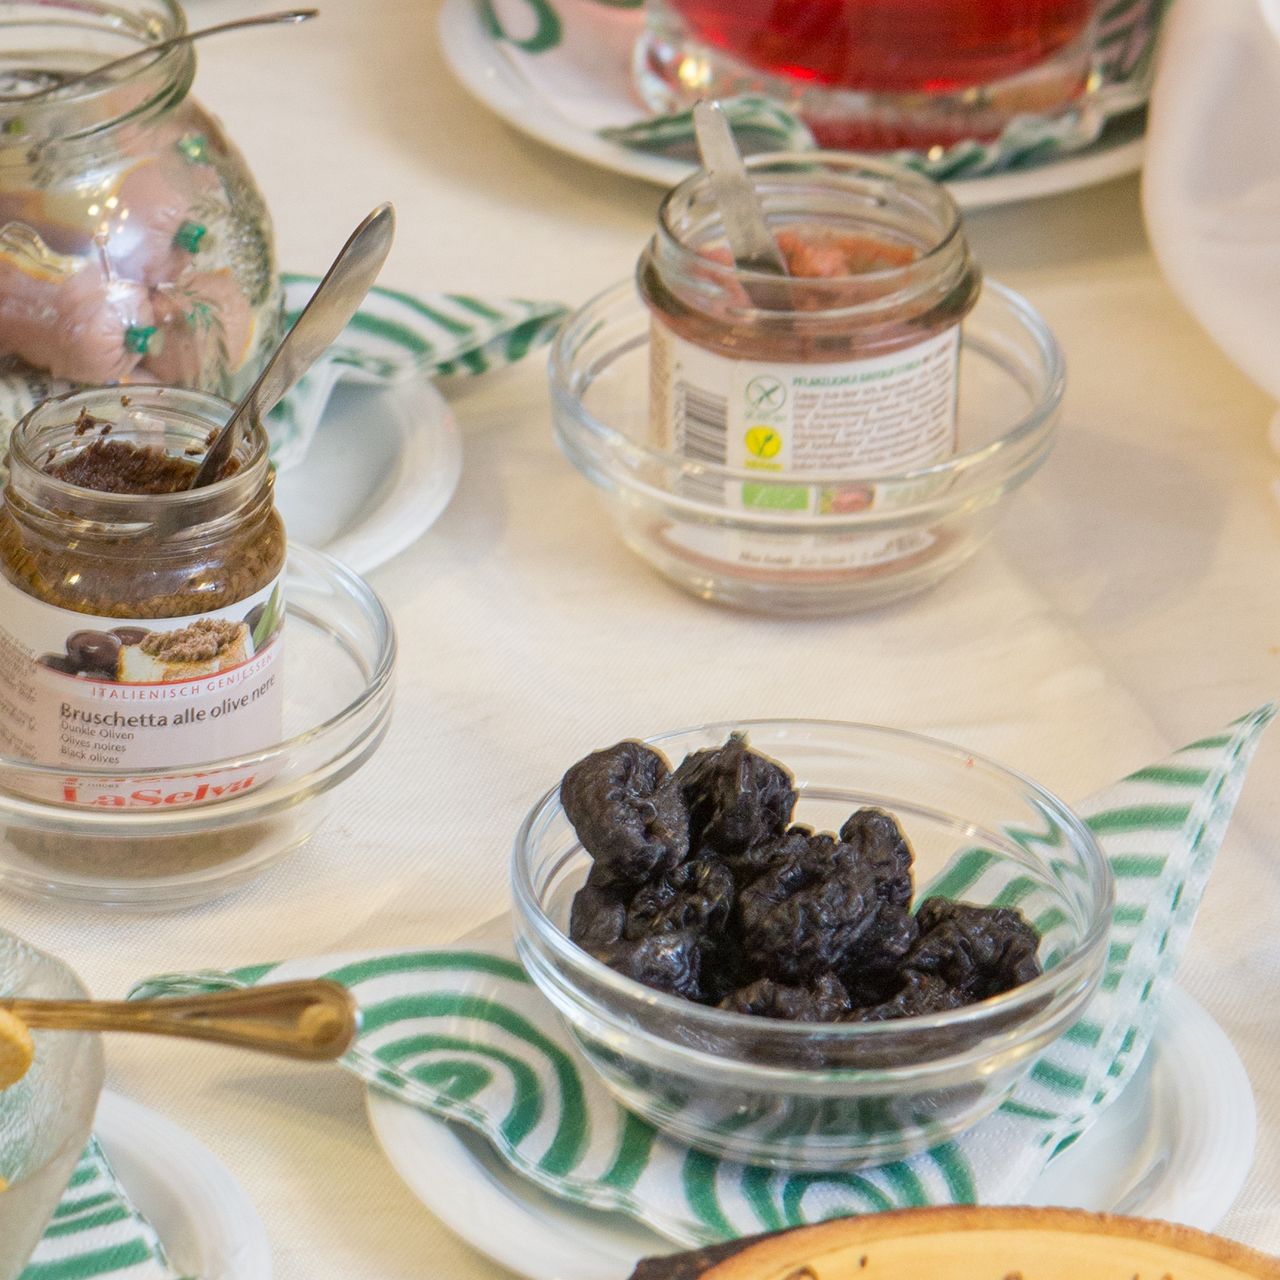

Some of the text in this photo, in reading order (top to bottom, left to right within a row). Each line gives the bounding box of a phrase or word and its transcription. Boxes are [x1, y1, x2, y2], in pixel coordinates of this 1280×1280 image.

[91, 654, 274, 700] ITALIENISCH GENIESSEN
[60, 673, 277, 728] Bruschetta alle olive nere
[61, 733, 127, 753] Olives noires
[99, 727, 135, 741] Oliven
[61, 746, 121, 765] Black olives
